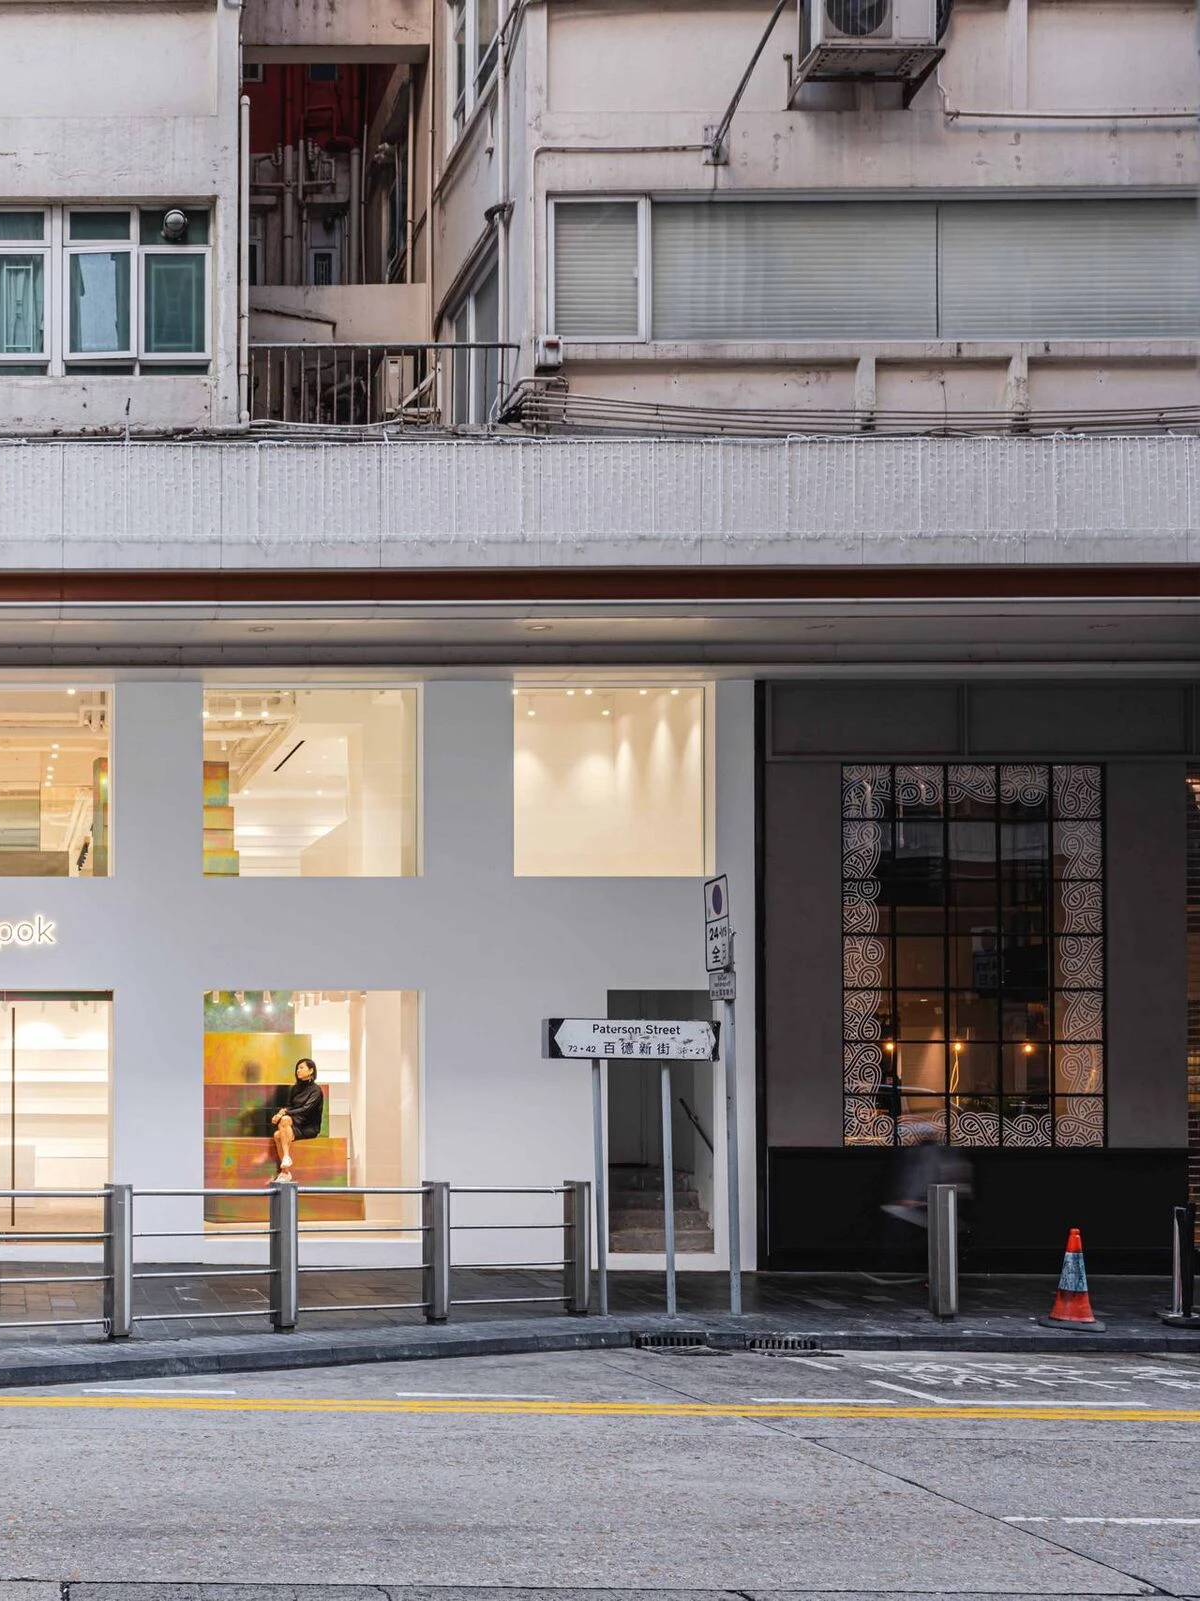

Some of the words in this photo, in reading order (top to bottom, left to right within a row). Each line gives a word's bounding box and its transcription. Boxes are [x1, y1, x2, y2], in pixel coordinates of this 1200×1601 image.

[592, 1024, 642, 1035] Paterson
[645, 1024, 681, 1035] Street
[603, 1041, 671, 1056] 百德新街
